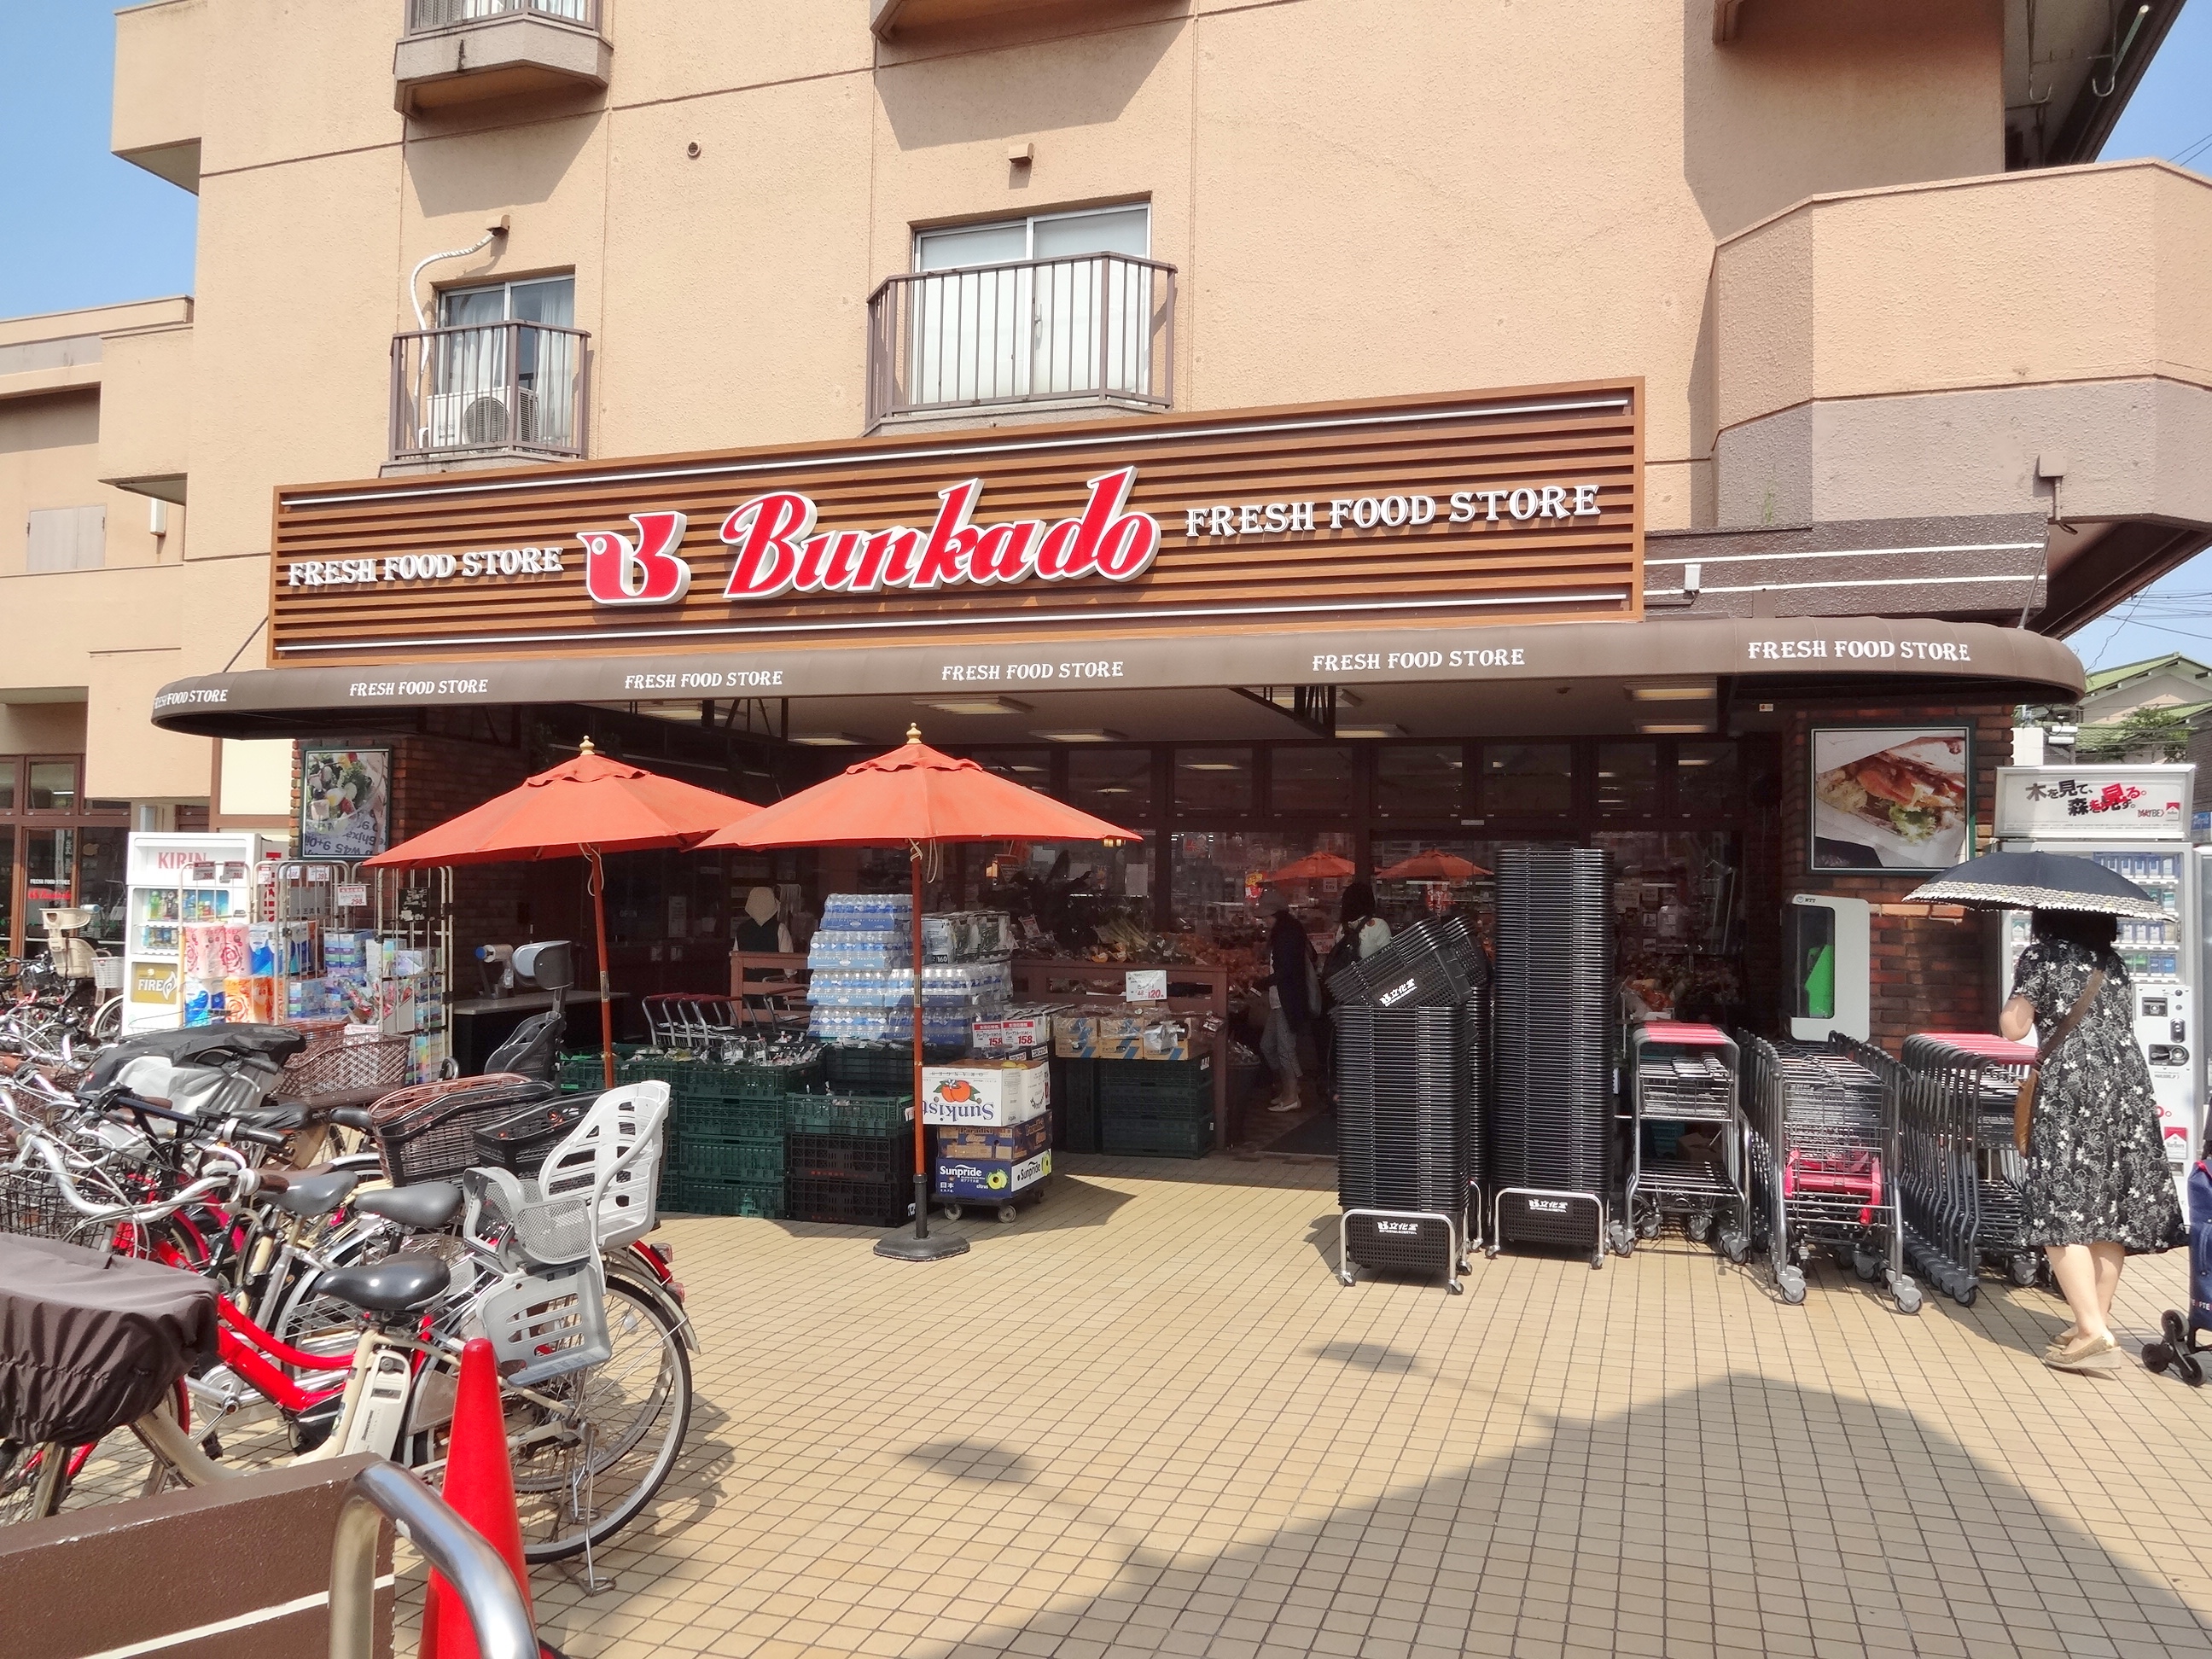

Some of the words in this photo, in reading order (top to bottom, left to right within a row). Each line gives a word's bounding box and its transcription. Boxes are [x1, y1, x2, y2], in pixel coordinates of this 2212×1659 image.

[1185, 500, 1317, 538] FRESH
[1329, 494, 1437, 530] FOOD
[1448, 484, 1602, 524] STORE
[719, 465, 1161, 600] Bunkado
[288, 558, 379, 587] FRESH
[383, 553, 457, 581] FOOD
[461, 546, 565, 577] STORE
[1313, 653, 1381, 672] FRESH
[1387, 650, 1443, 669] FOOD
[1448, 648, 1526, 667] STORE
[1748, 639, 1828, 660] FRESH
[1834, 640, 1895, 658] FOOD
[1900, 641, 1971, 661] STORE
[624, 672, 677, 690] FRESH
[680, 672, 723, 689] FOOD
[725, 670, 783, 687] STORE
[941, 664, 1001, 682] FRESH
[1005, 662, 1054, 680] FOOD
[1057, 661, 1124, 678] STORE
[167, 690, 189, 706] FOOD
[188, 689, 229, 703] STORE
[349, 681, 396, 697] FRESH
[398, 680, 434, 696] FOOD
[437, 678, 489, 694] STORE
[137, 979, 165, 992] FIRE
[1018, 1035, 1033, 1045] 158
[940, 1164, 982, 1179] Sunpride
[1021, 1161, 1041, 1180] Sunpride
